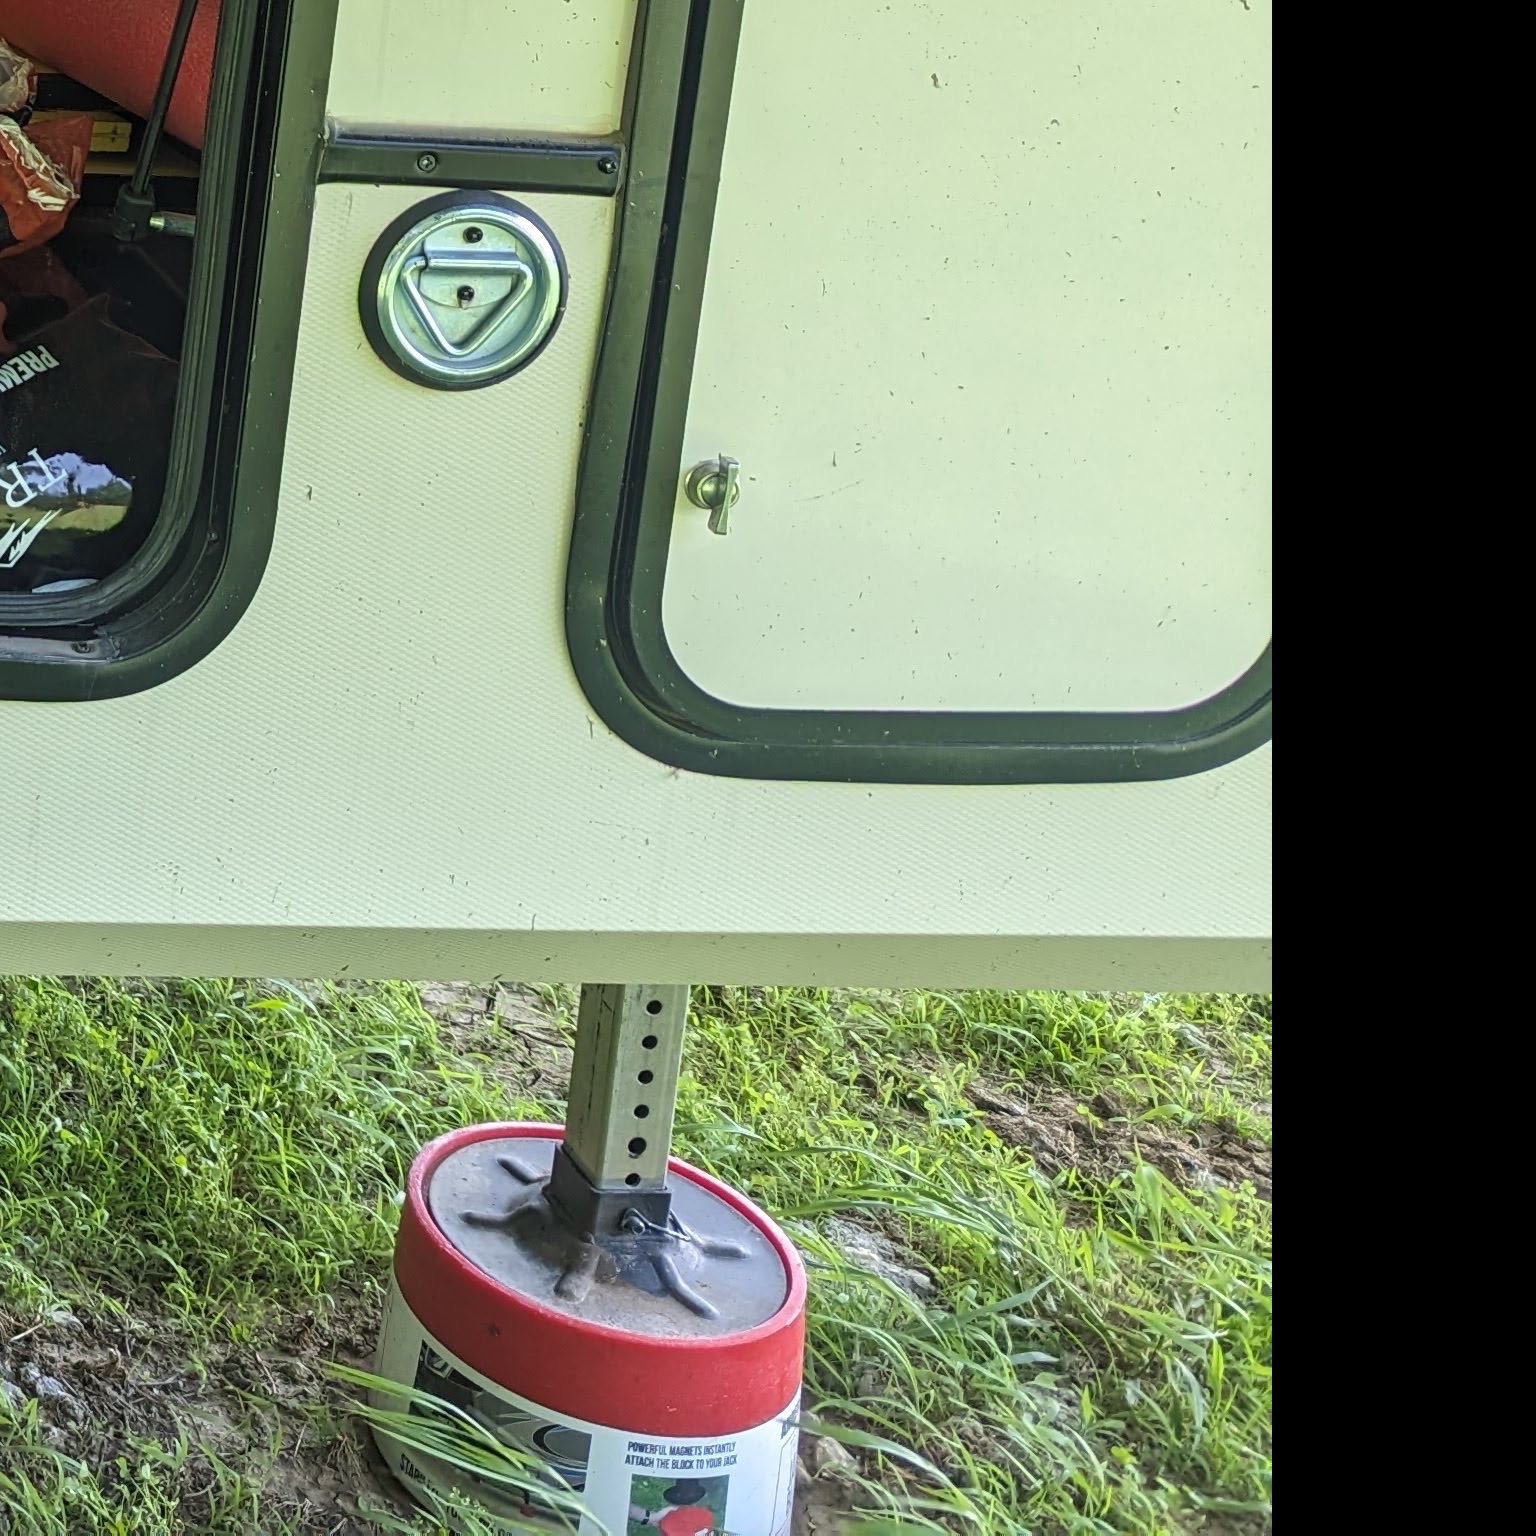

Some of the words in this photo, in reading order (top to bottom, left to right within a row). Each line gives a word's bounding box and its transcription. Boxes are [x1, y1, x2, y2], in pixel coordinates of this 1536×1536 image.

[627, 1441, 667, 1456] POWERFUL
[669, 1445, 702, 1456] MAGNETS
[703, 1441, 737, 1456] INSTANTLY
[625, 1454, 654, 1468] ATTACH
[656, 1457, 670, 1470] THE
[671, 1458, 695, 1470] BLOCK
[696, 1458, 704, 1470] TO
[705, 1457, 723, 1468] YOUR
[723, 1454, 737, 1467] JACK
